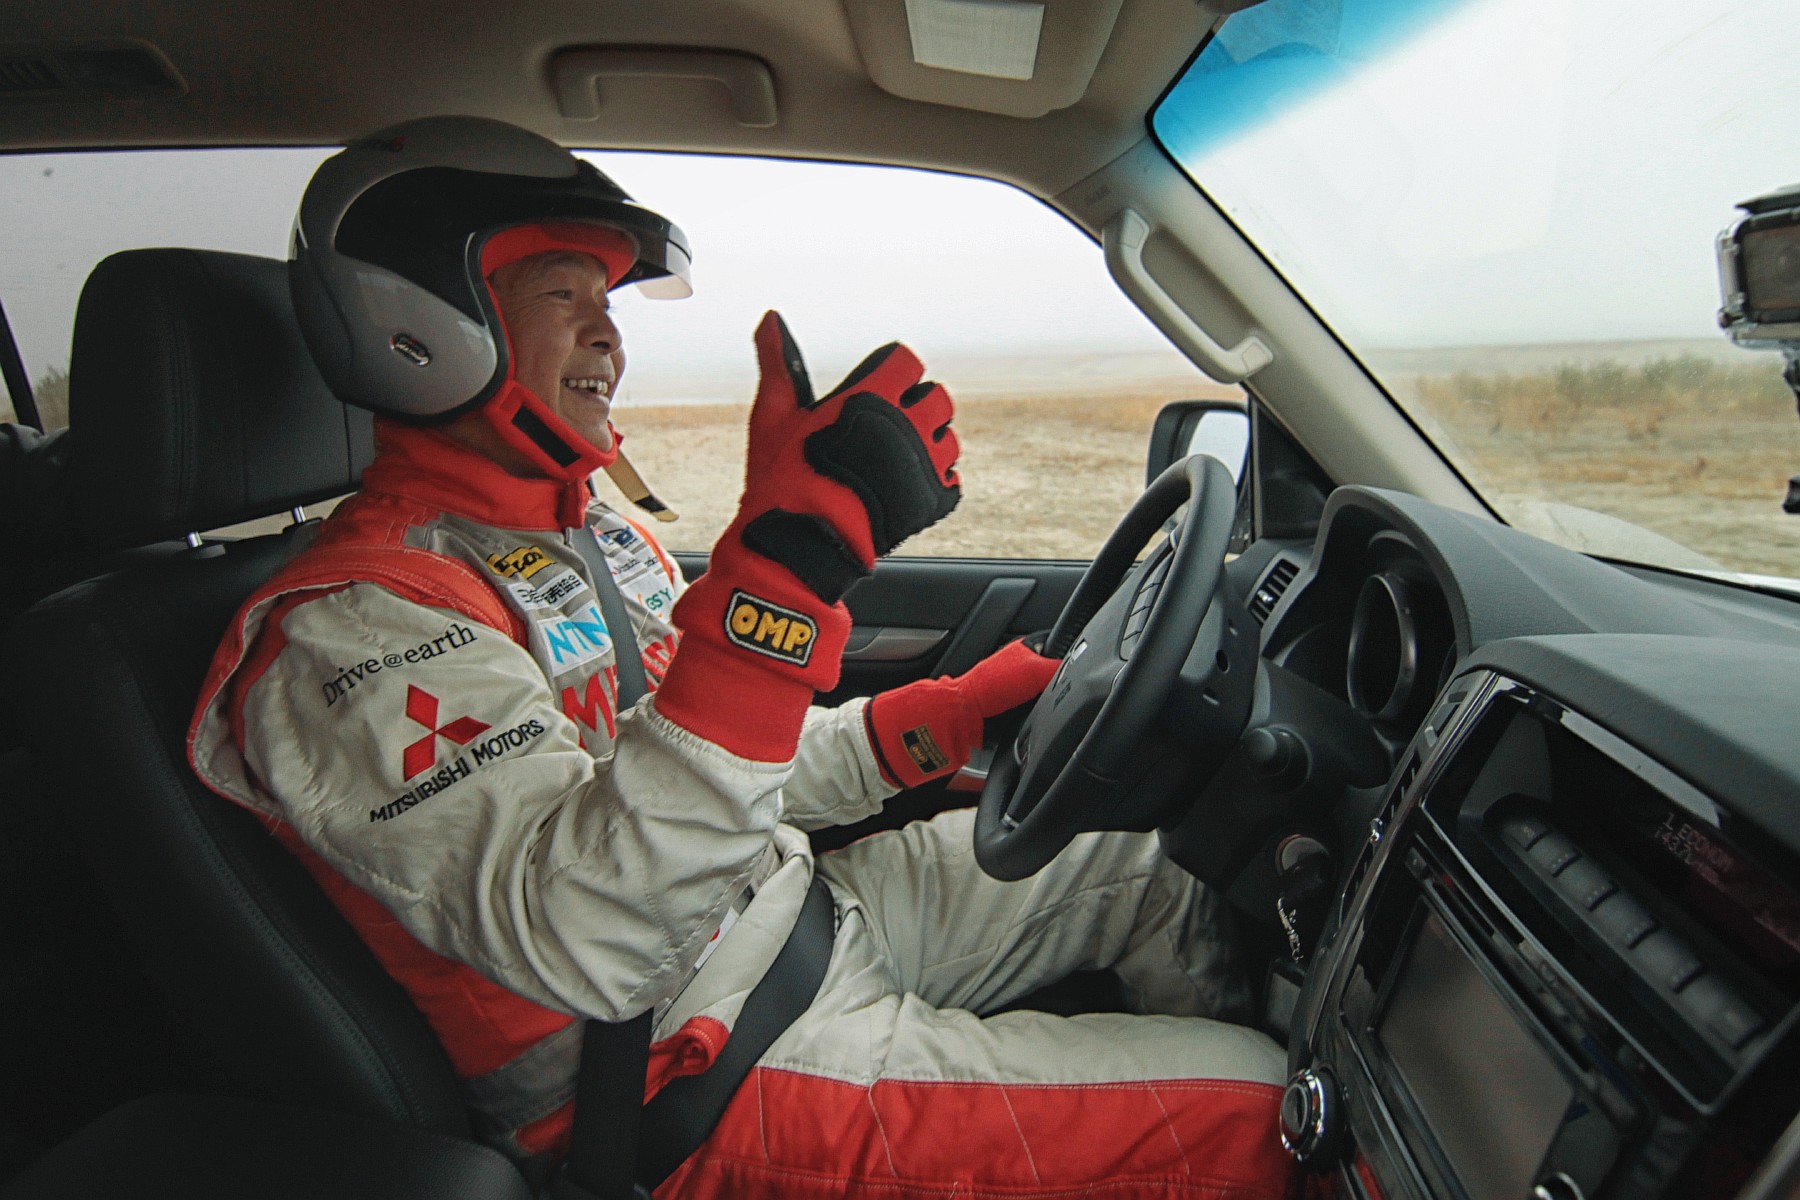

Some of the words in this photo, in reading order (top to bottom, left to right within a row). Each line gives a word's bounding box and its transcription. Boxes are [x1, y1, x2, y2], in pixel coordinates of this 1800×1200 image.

[544, 606, 611, 664] NTN
[731, 603, 813, 652] OMP
[322, 623, 477, 708] Drive@earth
[369, 756, 471, 823] MITSUBISHI
[471, 718, 545, 767] MOTORS
